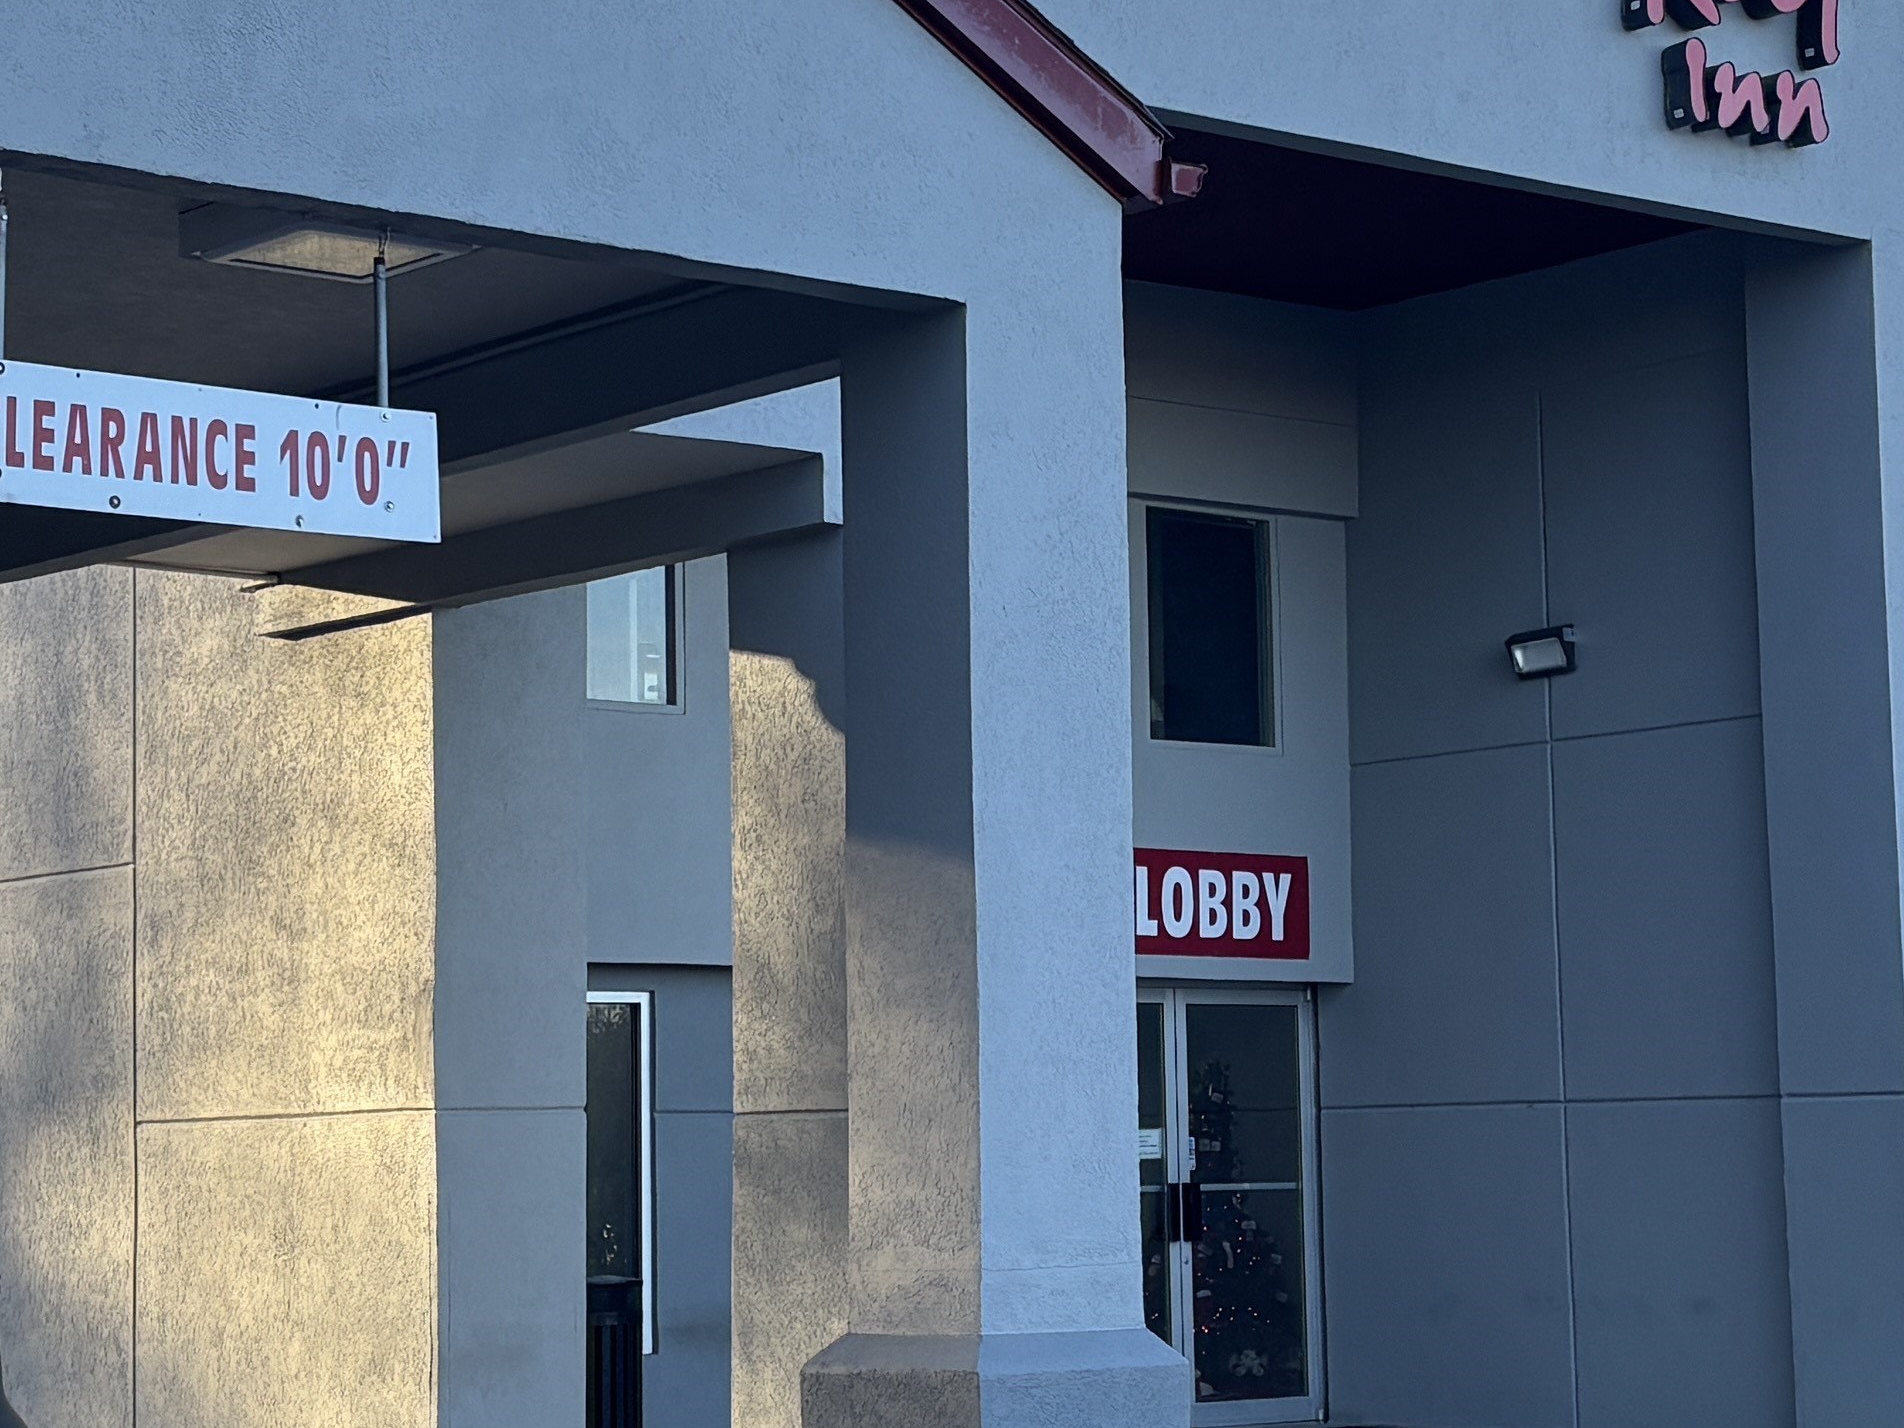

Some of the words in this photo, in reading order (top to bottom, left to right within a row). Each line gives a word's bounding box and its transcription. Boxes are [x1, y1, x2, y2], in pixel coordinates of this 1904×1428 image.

[1684, 36, 1831, 146] Inn
[278, 428, 411, 506] 10'0"
[1135, 865, 1293, 942] LOBBY
